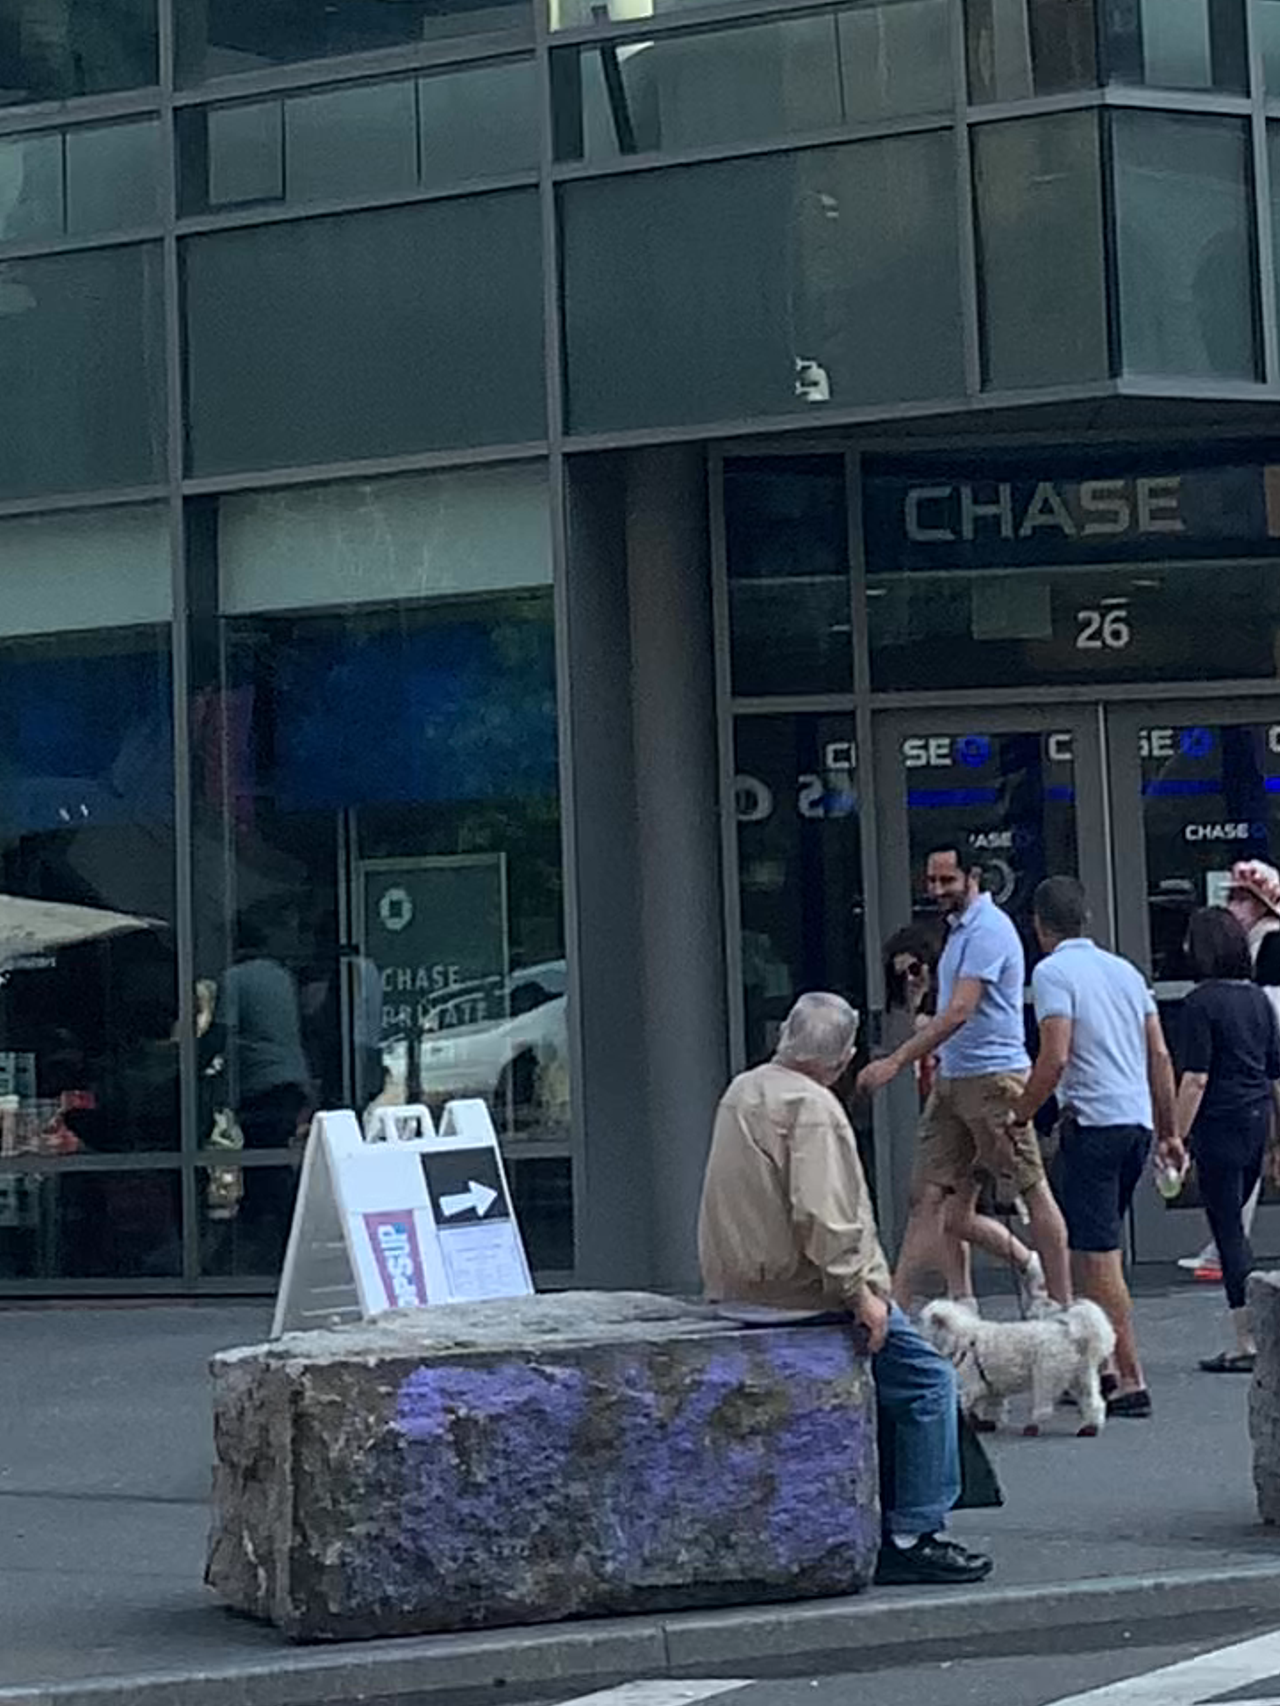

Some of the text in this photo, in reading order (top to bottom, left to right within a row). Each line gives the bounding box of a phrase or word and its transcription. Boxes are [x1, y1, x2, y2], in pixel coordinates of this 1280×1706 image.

[904, 475, 1187, 542] CHASE
[1075, 609, 1130, 649] 26
[1184, 823, 1249, 842] CHASE
